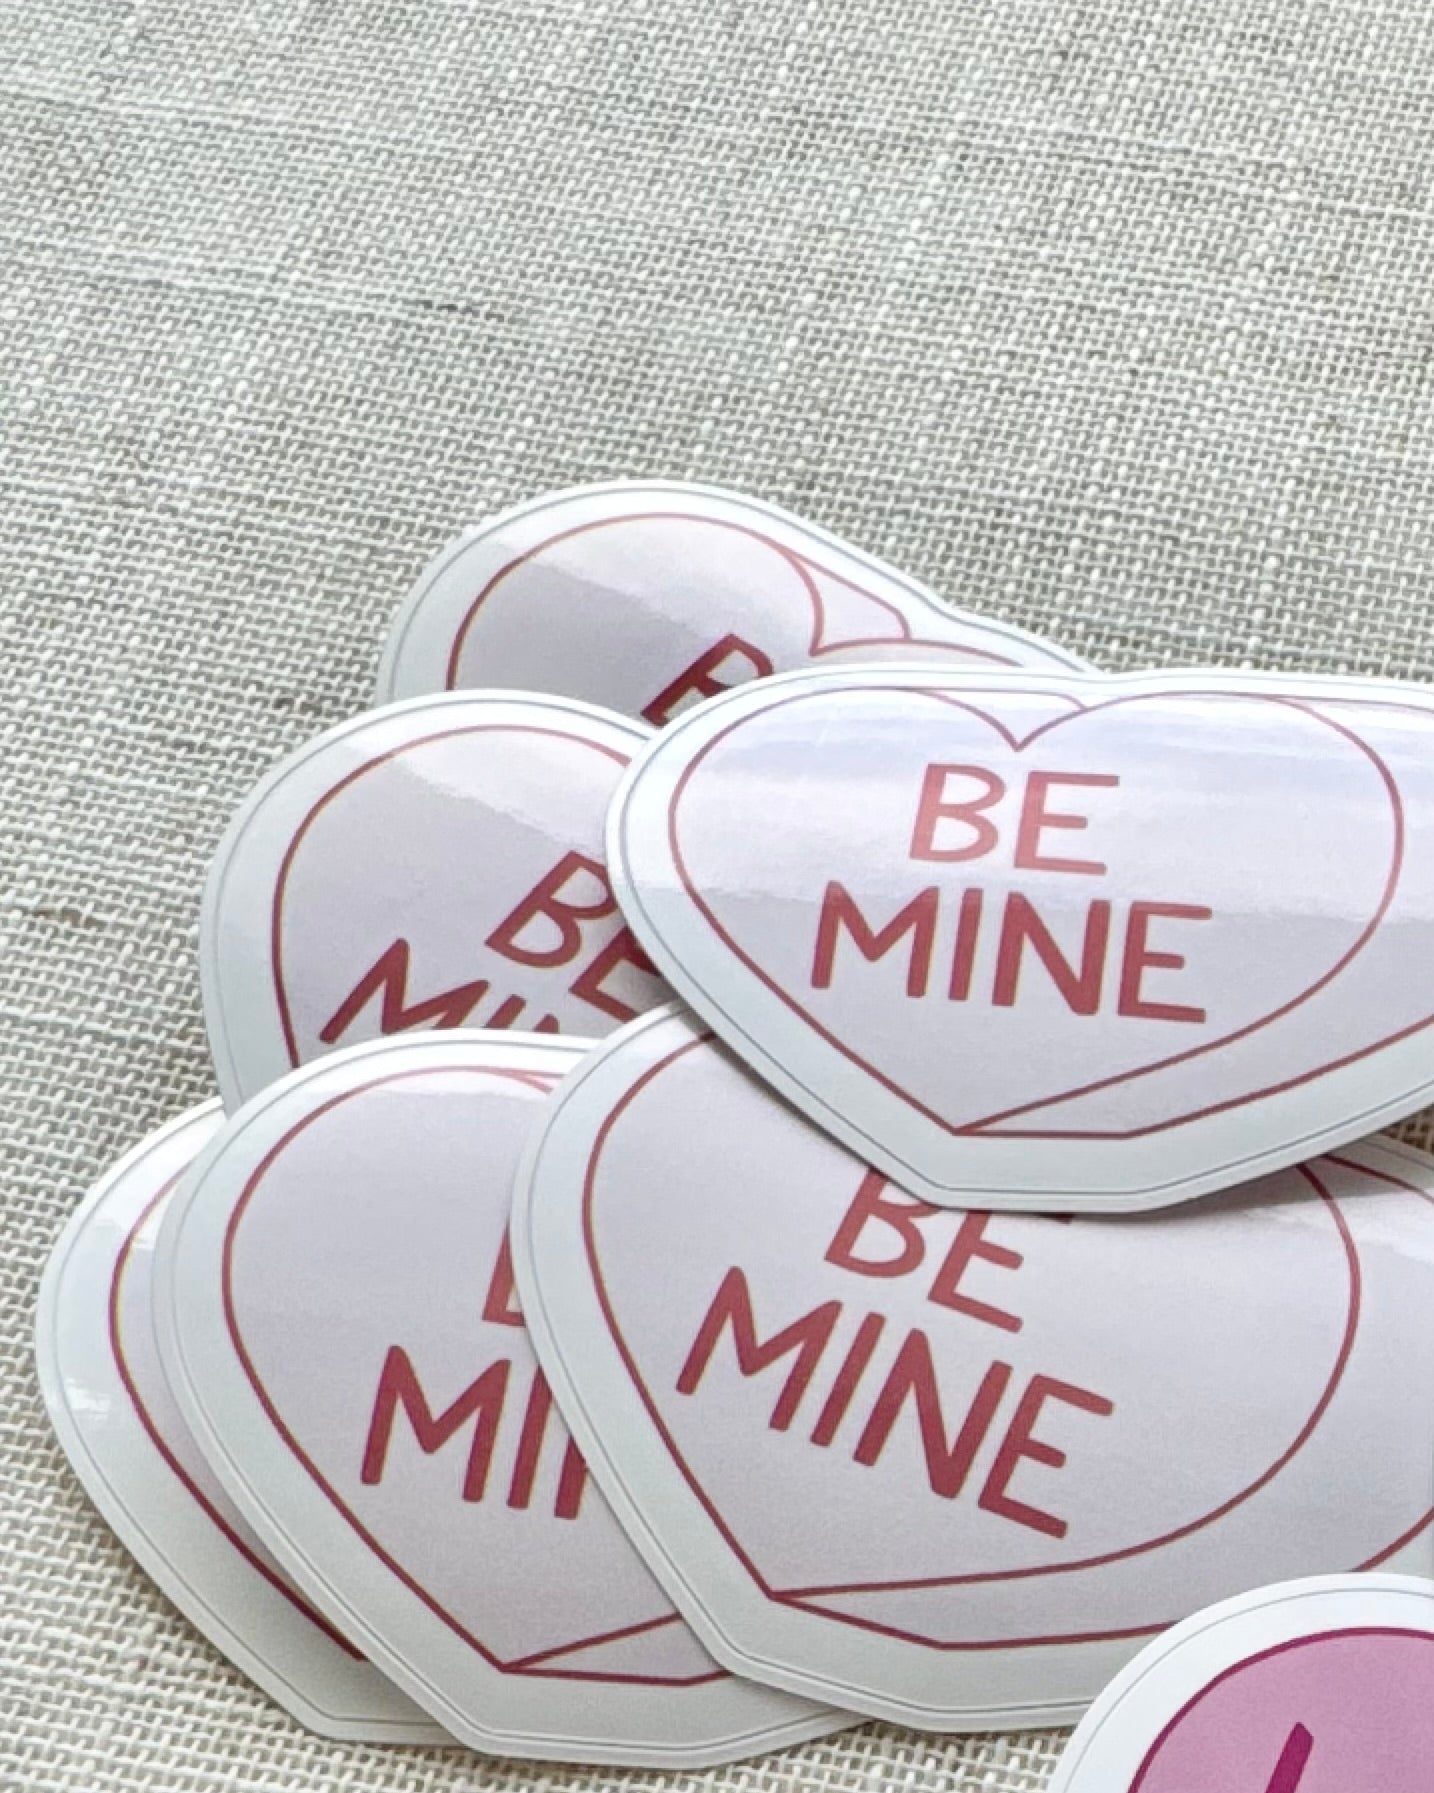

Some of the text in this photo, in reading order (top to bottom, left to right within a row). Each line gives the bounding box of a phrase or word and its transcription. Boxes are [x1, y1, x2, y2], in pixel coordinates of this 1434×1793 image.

[909, 763, 1119, 875] BE
[811, 880, 1212, 1024] MINE
[825, 1167, 1075, 1333] BE
[361, 1345, 589, 1520] MI
[675, 1265, 1115, 1540] MINE
